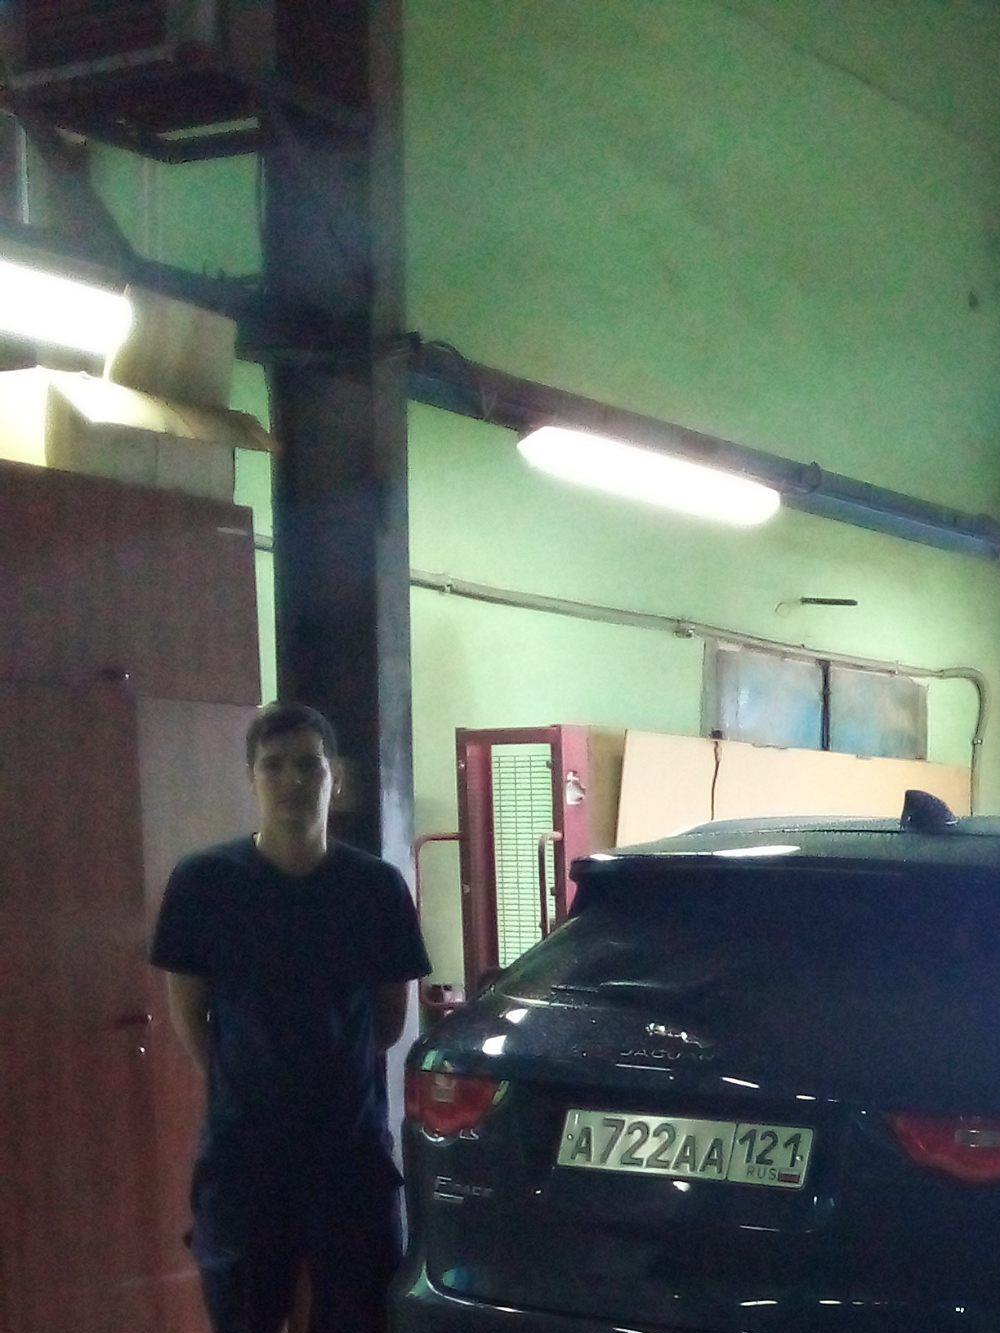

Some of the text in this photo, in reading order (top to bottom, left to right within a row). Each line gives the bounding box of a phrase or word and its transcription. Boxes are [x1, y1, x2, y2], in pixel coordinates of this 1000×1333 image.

[570, 1117, 803, 1174] A722AA 121
[746, 1167, 779, 1181] RUS
